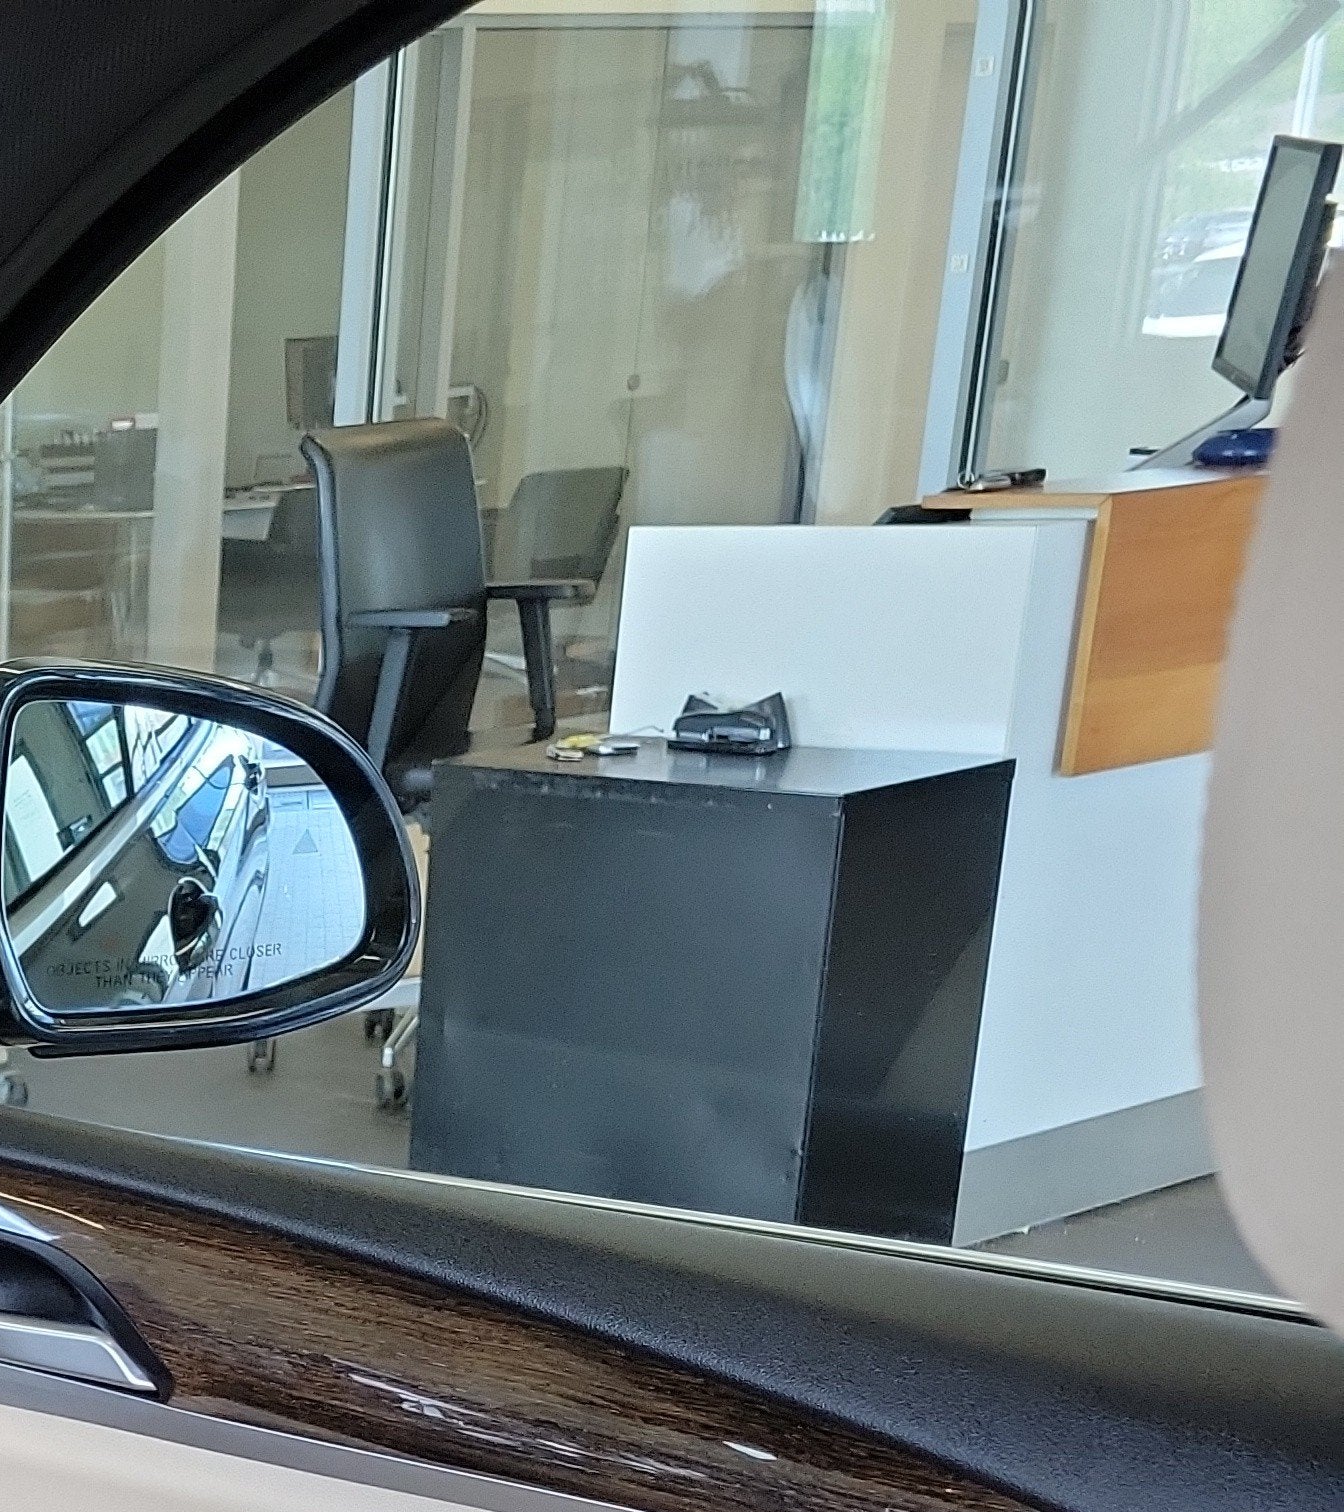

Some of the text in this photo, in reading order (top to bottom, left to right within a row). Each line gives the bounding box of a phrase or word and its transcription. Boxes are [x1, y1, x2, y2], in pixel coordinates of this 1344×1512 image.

[46, 961, 111, 978] OBJECTS
[229, 942, 282, 961] CLOSER
[95, 972, 133, 988] THAN
